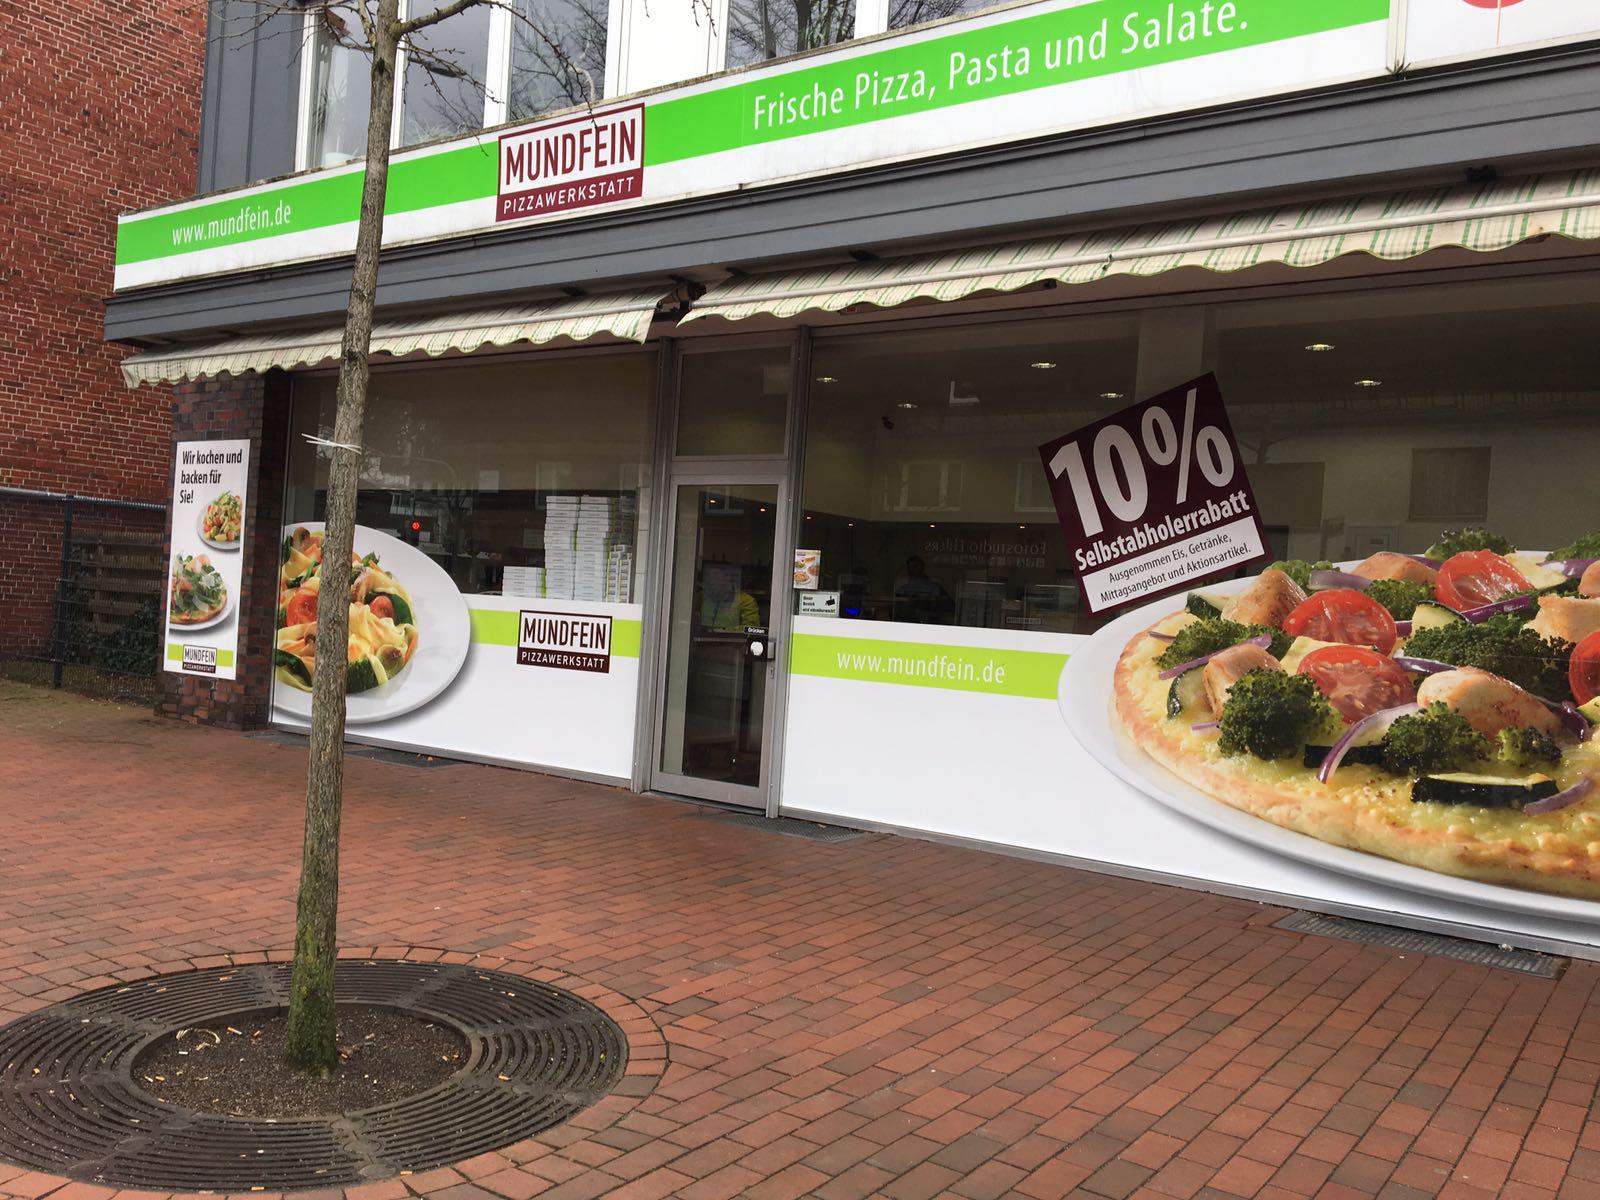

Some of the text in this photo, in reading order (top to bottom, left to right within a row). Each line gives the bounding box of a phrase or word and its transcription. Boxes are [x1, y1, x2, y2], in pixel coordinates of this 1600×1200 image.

[754, 0, 1248, 130] Frische Pizza, Pasta und Salate.
[505, 118, 636, 186] MUNDFEIN
[503, 176, 634, 215] PIZZAWERKSTATT
[172, 199, 292, 246] www.mundfein.de
[182, 448, 242, 465] Wir kochen und
[1049, 387, 1235, 538] 10%
[180, 489, 193, 504] Sie!
[181, 469, 221, 485] backen für
[1075, 489, 1250, 571] Selbstabholerrabatt
[1100, 543, 1251, 603] Mittagsangebot und Aktionsartikel.
[1108, 531, 1232, 584] Ausgenommen Eis, Getränke,
[523, 617, 607, 649] MUNDFEIN
[185, 648, 215, 663] MUNDFEIN
[521, 651, 604, 669] PIZZAWERKSTATT
[836, 651, 1006, 684] www.mundfein.de
